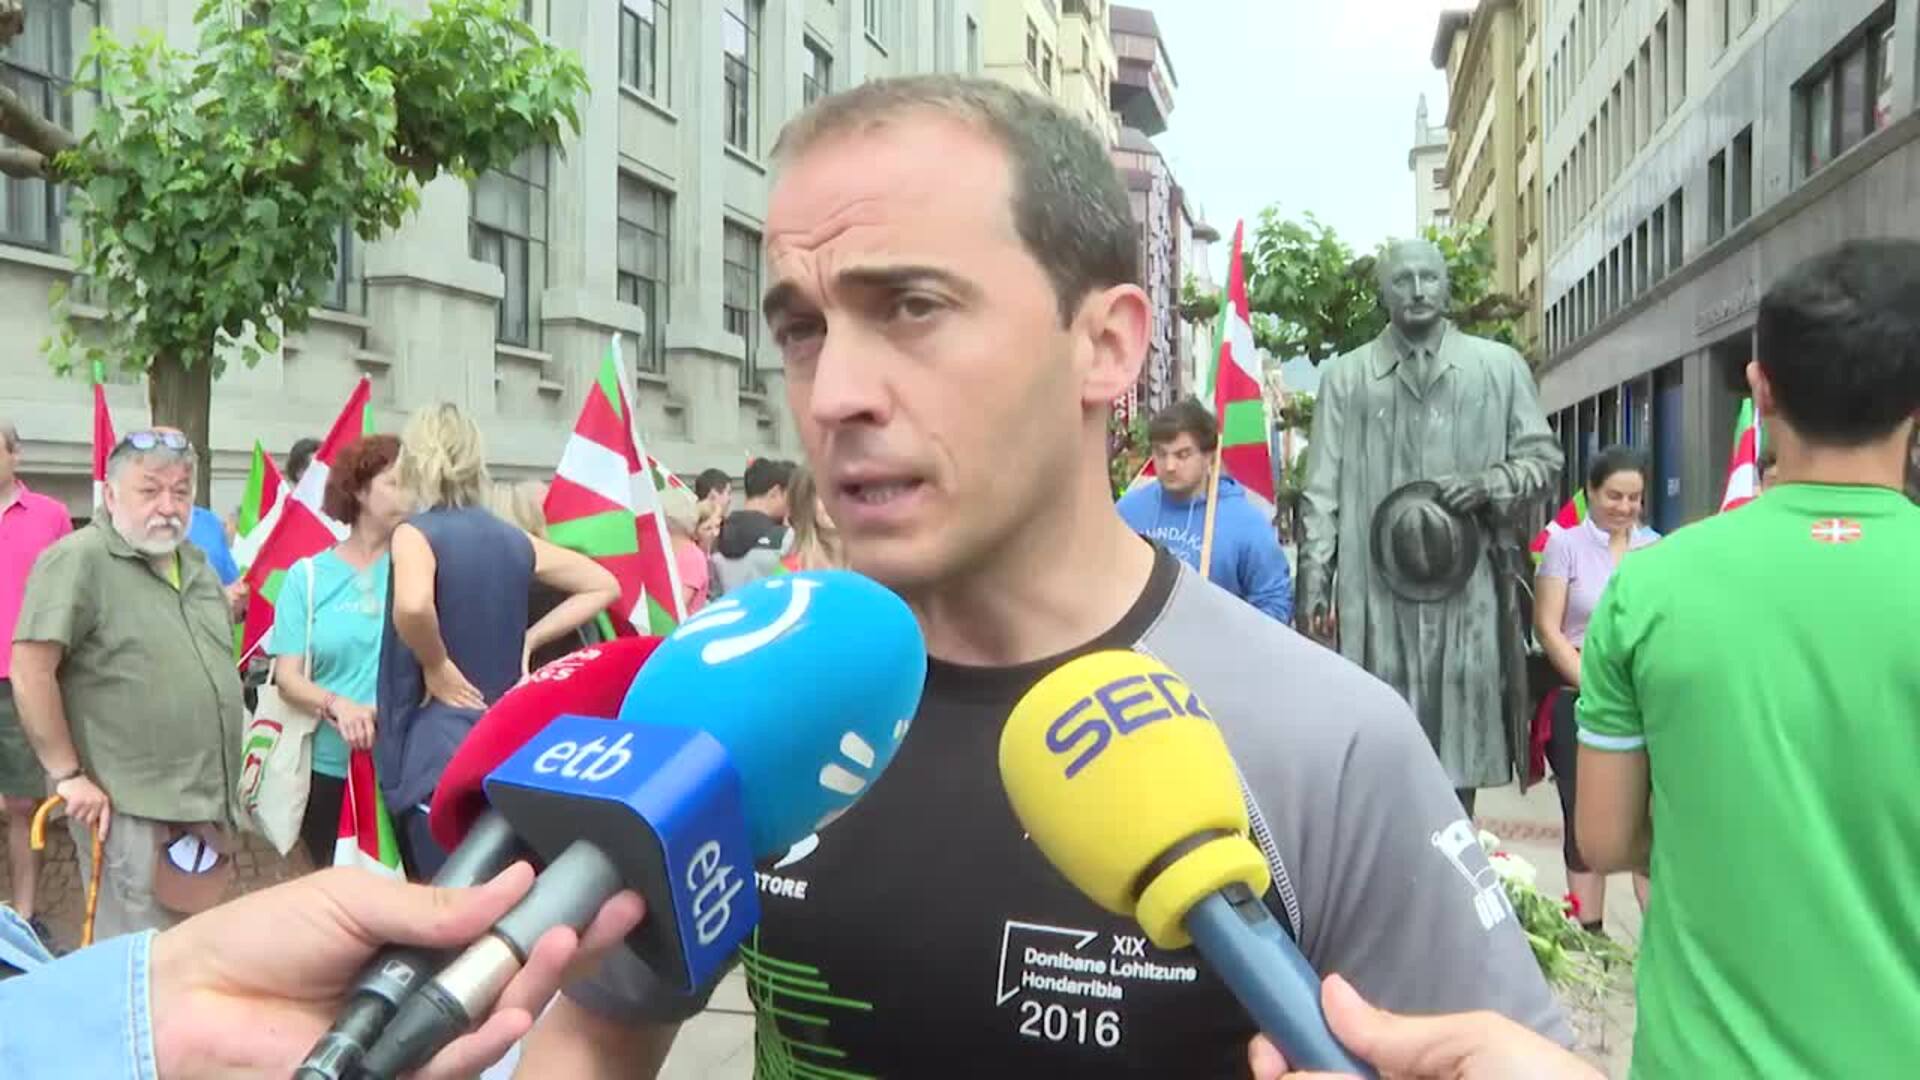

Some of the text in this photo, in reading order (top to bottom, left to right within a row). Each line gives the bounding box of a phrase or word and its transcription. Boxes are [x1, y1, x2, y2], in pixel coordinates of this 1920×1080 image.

[533, 732, 634, 782] etb
[686, 839, 744, 945] etb
[1024, 947, 1198, 982] Donibane Lohitzune
[1111, 935, 1147, 957] XIX
[1022, 971, 1124, 1000] Hondarribia
[1019, 1000, 1121, 1047] 2016
